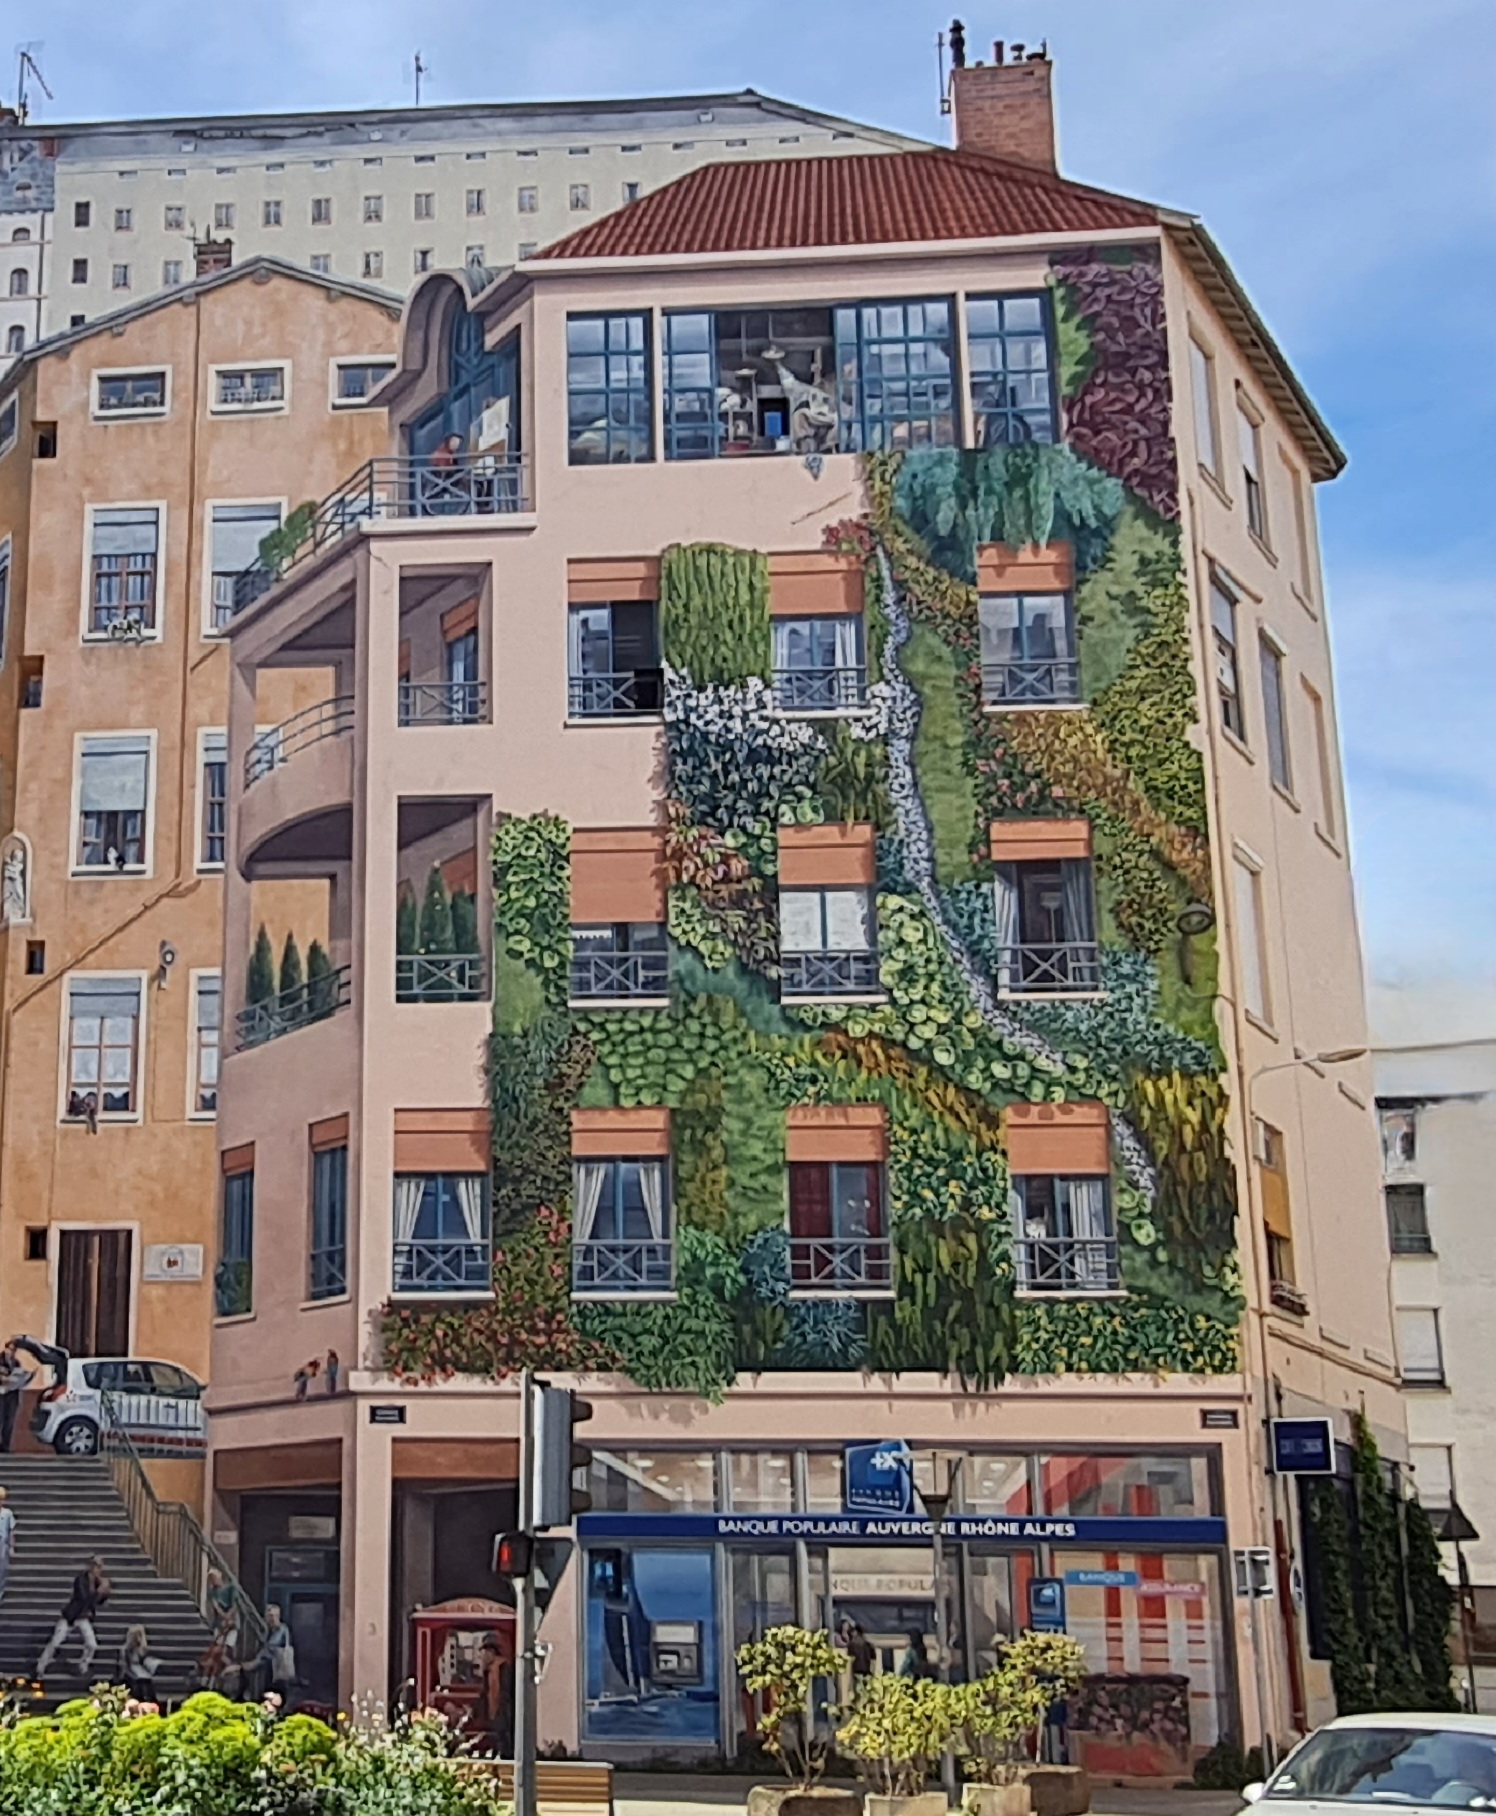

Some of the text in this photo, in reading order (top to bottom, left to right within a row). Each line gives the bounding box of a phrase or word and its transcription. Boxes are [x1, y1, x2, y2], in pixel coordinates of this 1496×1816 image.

[718, 1519, 779, 1535] BANQUE
[782, 1519, 861, 1535] POPULAIRE
[960, 1518, 1020, 1536] RHÔNE
[1023, 1522, 1076, 1536] ALPES
